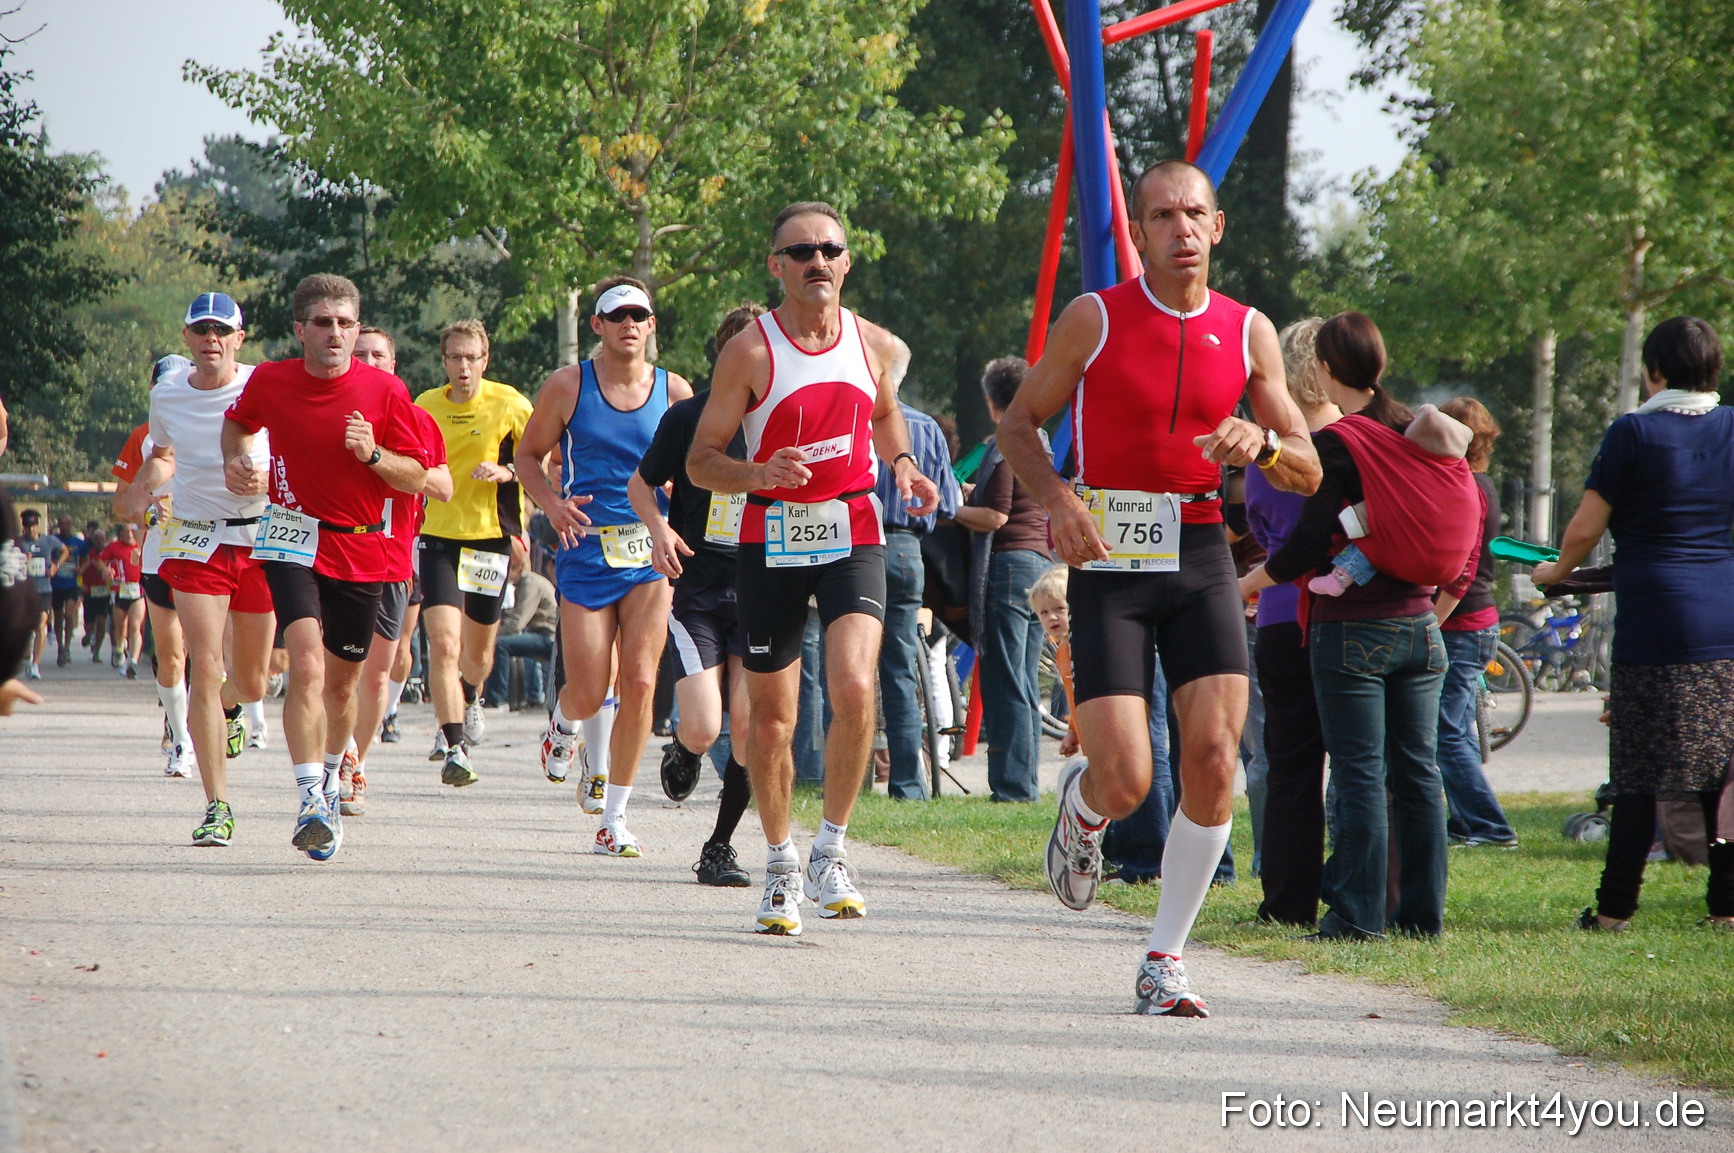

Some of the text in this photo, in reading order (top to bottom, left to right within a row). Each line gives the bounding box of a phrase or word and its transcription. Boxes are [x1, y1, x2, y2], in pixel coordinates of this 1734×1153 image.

[813, 444, 838, 457] DEHN
[276, 455, 297, 504] BÖGL
[712, 508, 718, 516] B
[788, 504, 809, 518] Karl
[1109, 497, 1152, 512] Konrad
[272, 508, 303, 523] Herbert
[181, 519, 216, 533] Reinhard
[770, 524, 776, 533] A
[790, 522, 838, 542] 2521
[1117, 522, 1163, 544] 756
[179, 533, 210, 548] 448
[268, 525, 311, 545] 2227
[627, 536, 654, 555] 670
[1141, 558, 1177, 566] PFLEIDERER
[475, 568, 498, 581] 400
